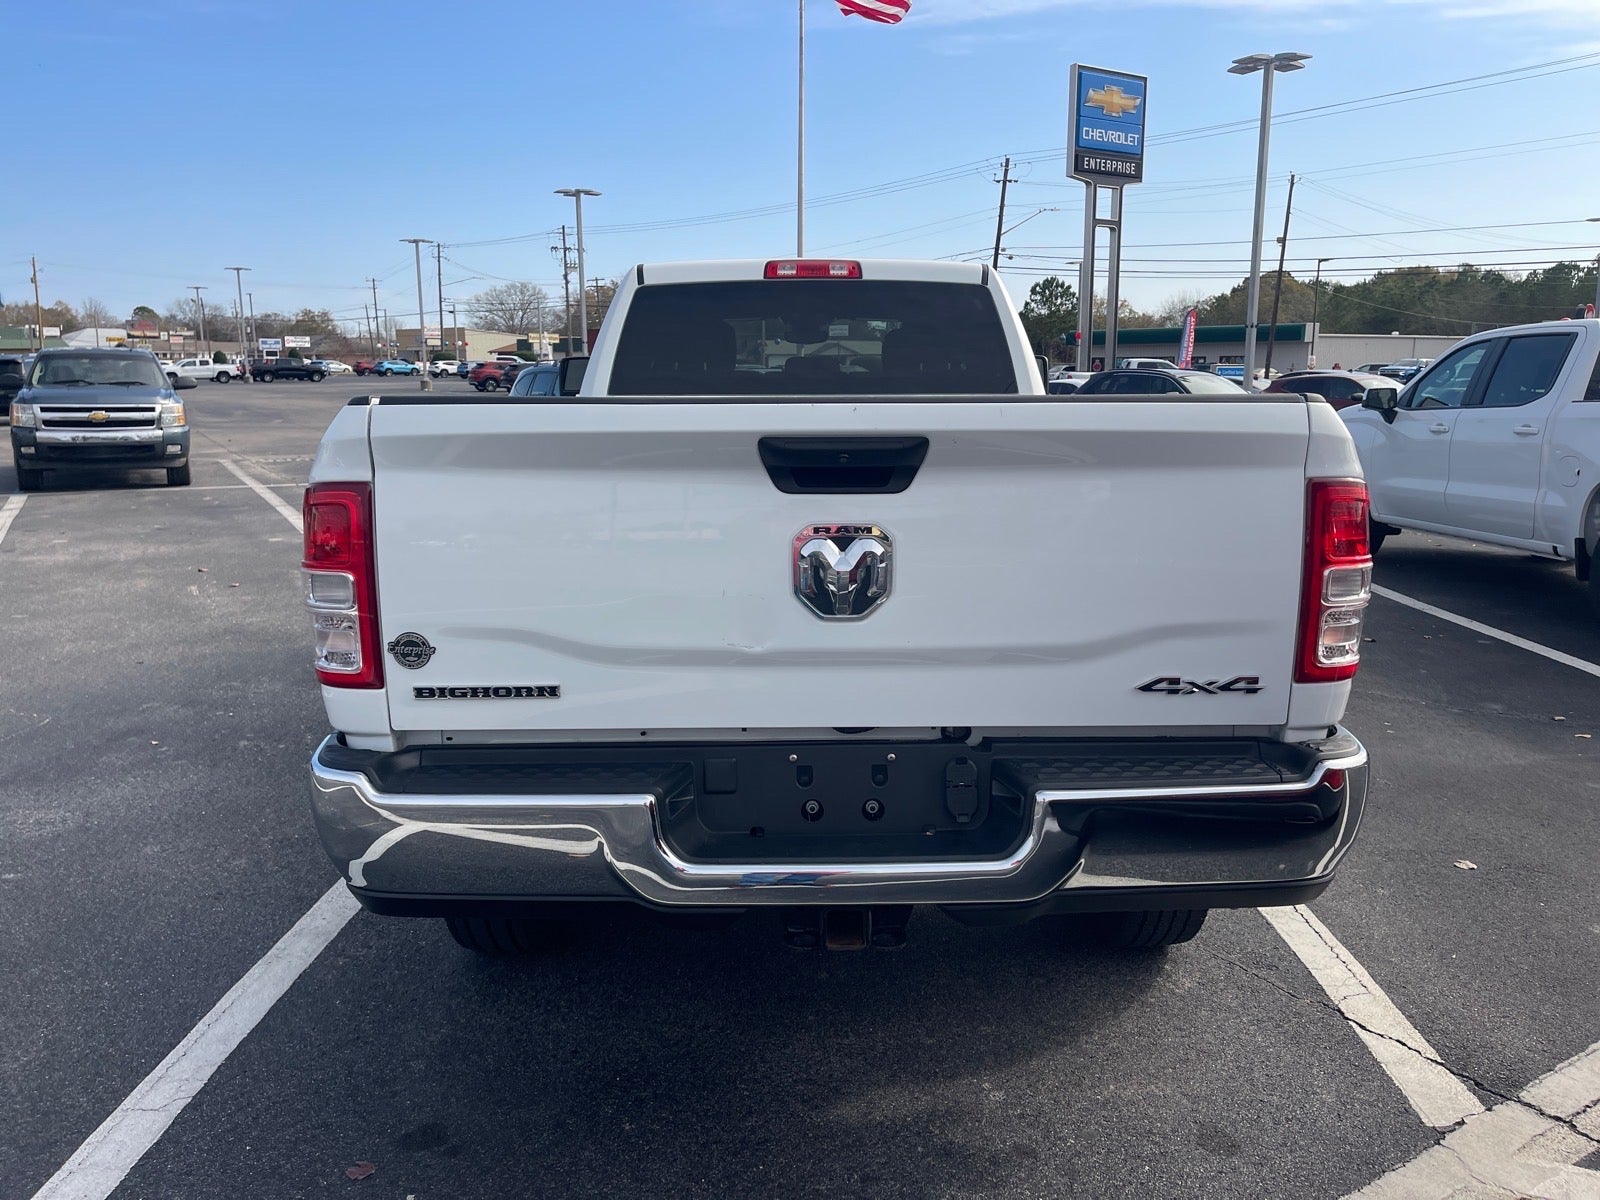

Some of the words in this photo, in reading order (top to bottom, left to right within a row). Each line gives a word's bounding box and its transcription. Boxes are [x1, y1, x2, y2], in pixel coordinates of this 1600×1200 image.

[1082, 127, 1140, 146] CHEVROLET
[1084, 157, 1136, 174] ENTERPRISE
[812, 526, 873, 535] RAM
[388, 642, 436, 657] Enterprise
[413, 685, 560, 699] BIGHORN
[1134, 675, 1264, 695] 4x4
